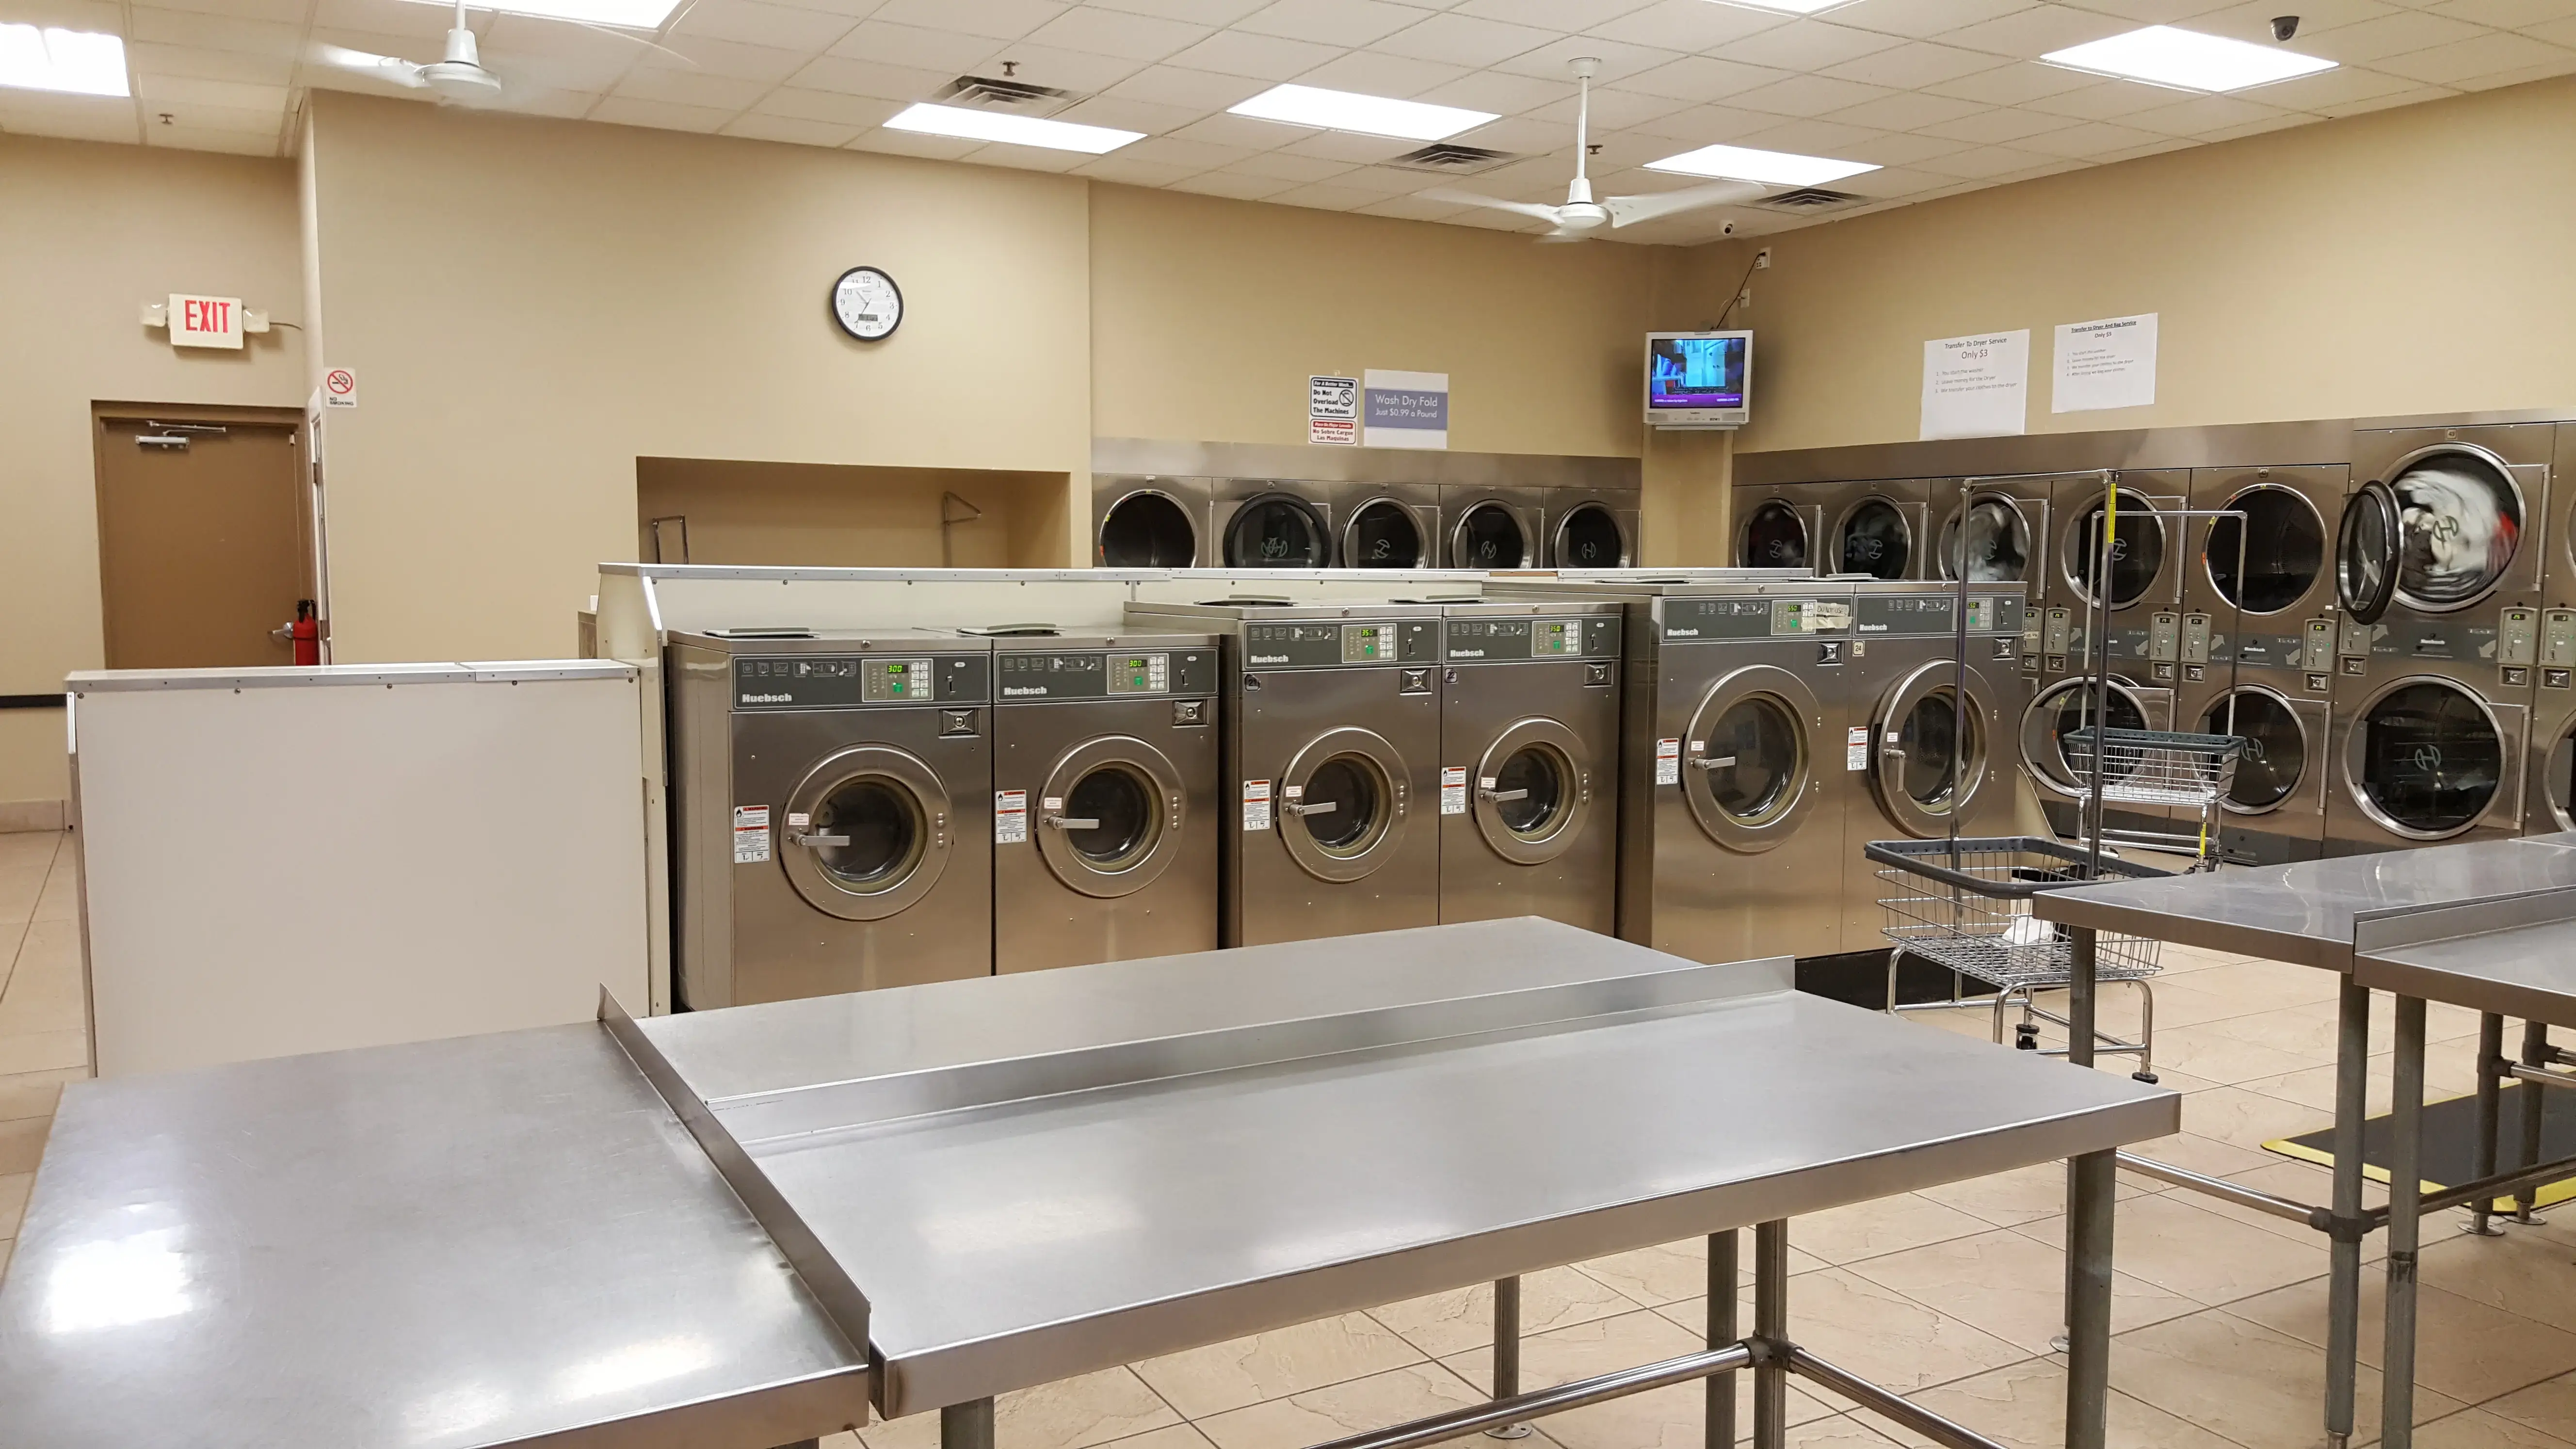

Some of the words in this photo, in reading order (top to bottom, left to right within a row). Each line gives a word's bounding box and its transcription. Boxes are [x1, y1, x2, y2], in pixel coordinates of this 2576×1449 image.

[185, 299, 230, 333] EXIT
[1962, 351, 1978, 359] Only
[1980, 349, 1988, 358] $3
[1375, 394, 1399, 404] Wash
[1402, 396, 1417, 407] Dry
[1419, 397, 1437, 406] Fold
[1389, 408, 1409, 416] $0.99
[1450, 649, 1484, 658] Huebsch
[1251, 655, 1289, 663] Huebsch
[1004, 686, 1047, 695] Huebsch
[742, 693, 792, 703] Huebsch
